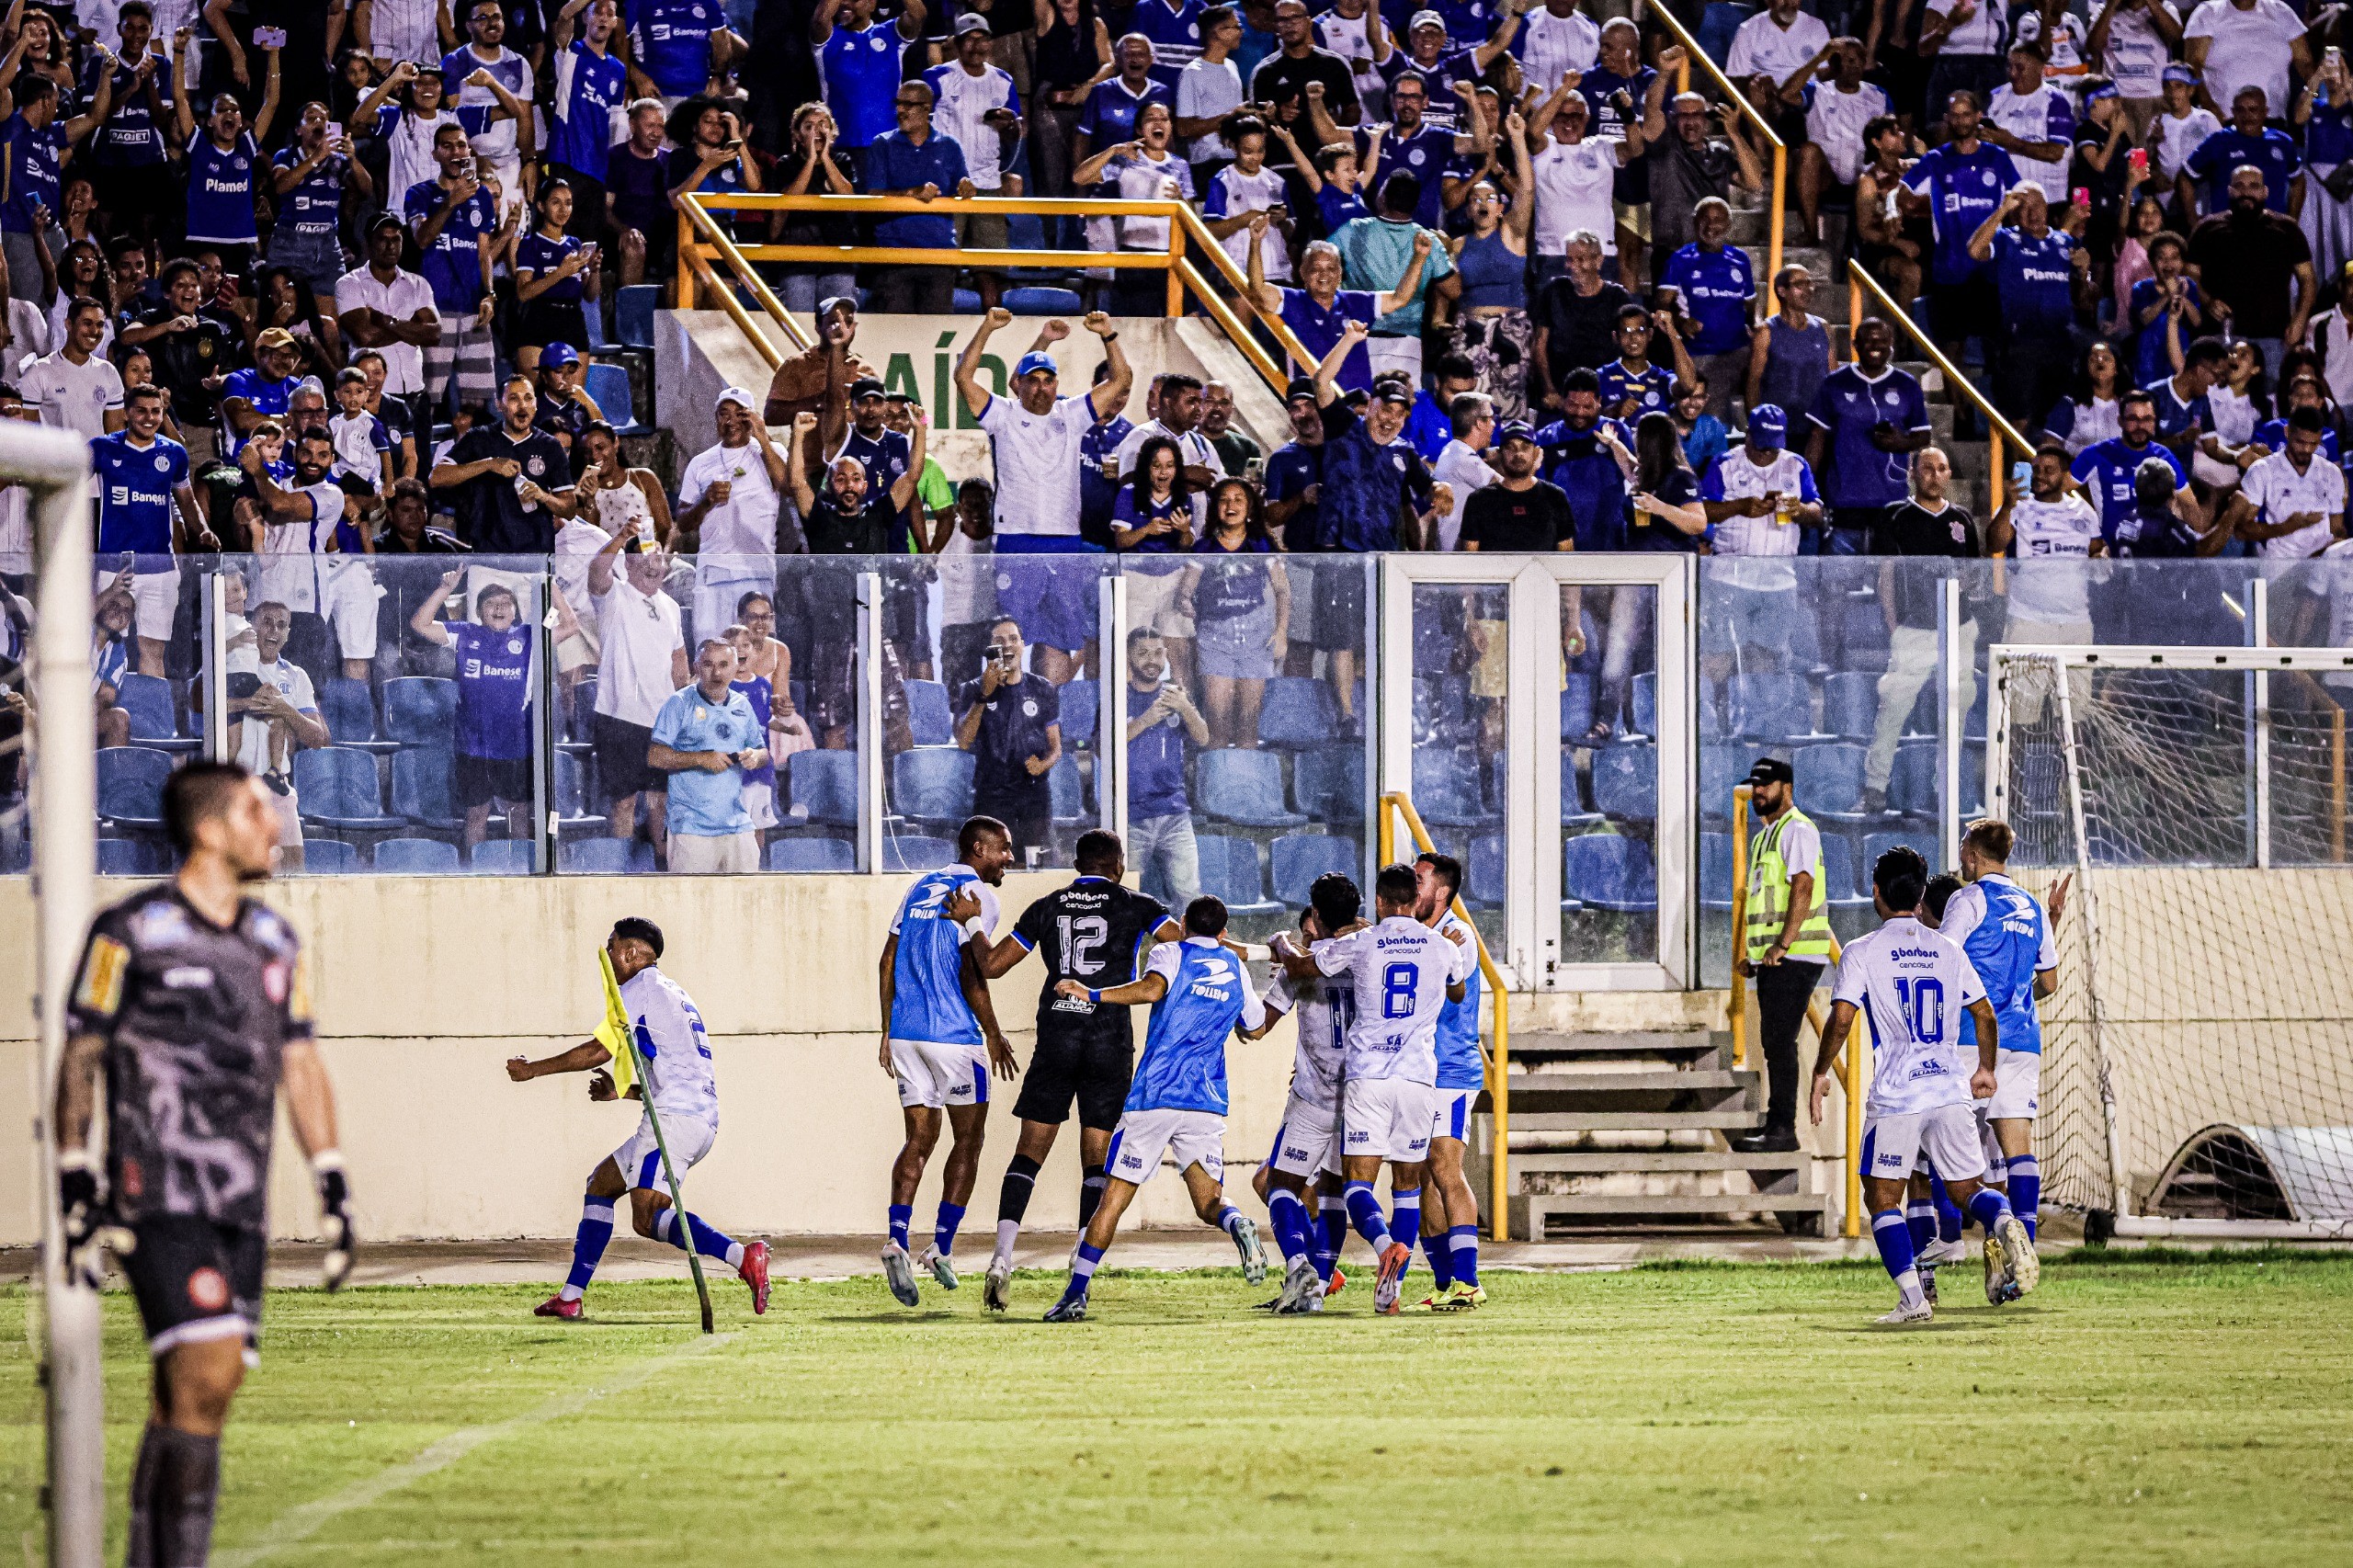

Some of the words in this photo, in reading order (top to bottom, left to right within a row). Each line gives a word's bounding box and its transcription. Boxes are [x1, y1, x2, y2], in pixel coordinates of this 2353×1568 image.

[206, 178, 248, 192] Plamed
[883, 331, 1007, 429] AÍD
[131, 490, 166, 503] Banese
[483, 665, 521, 676] Banese
[1060, 892, 1109, 903] gbarbosa
[1065, 902, 1102, 910] cencosud
[1057, 915, 1108, 975] 12
[1377, 936, 1428, 949] gbarbosa
[1383, 947, 1422, 955] cencosud
[1891, 946, 1939, 961] gbarbosa
[1899, 961, 1934, 970] cencosud
[1381, 961, 1420, 1019] 8
[1893, 977, 1944, 1044] 10
